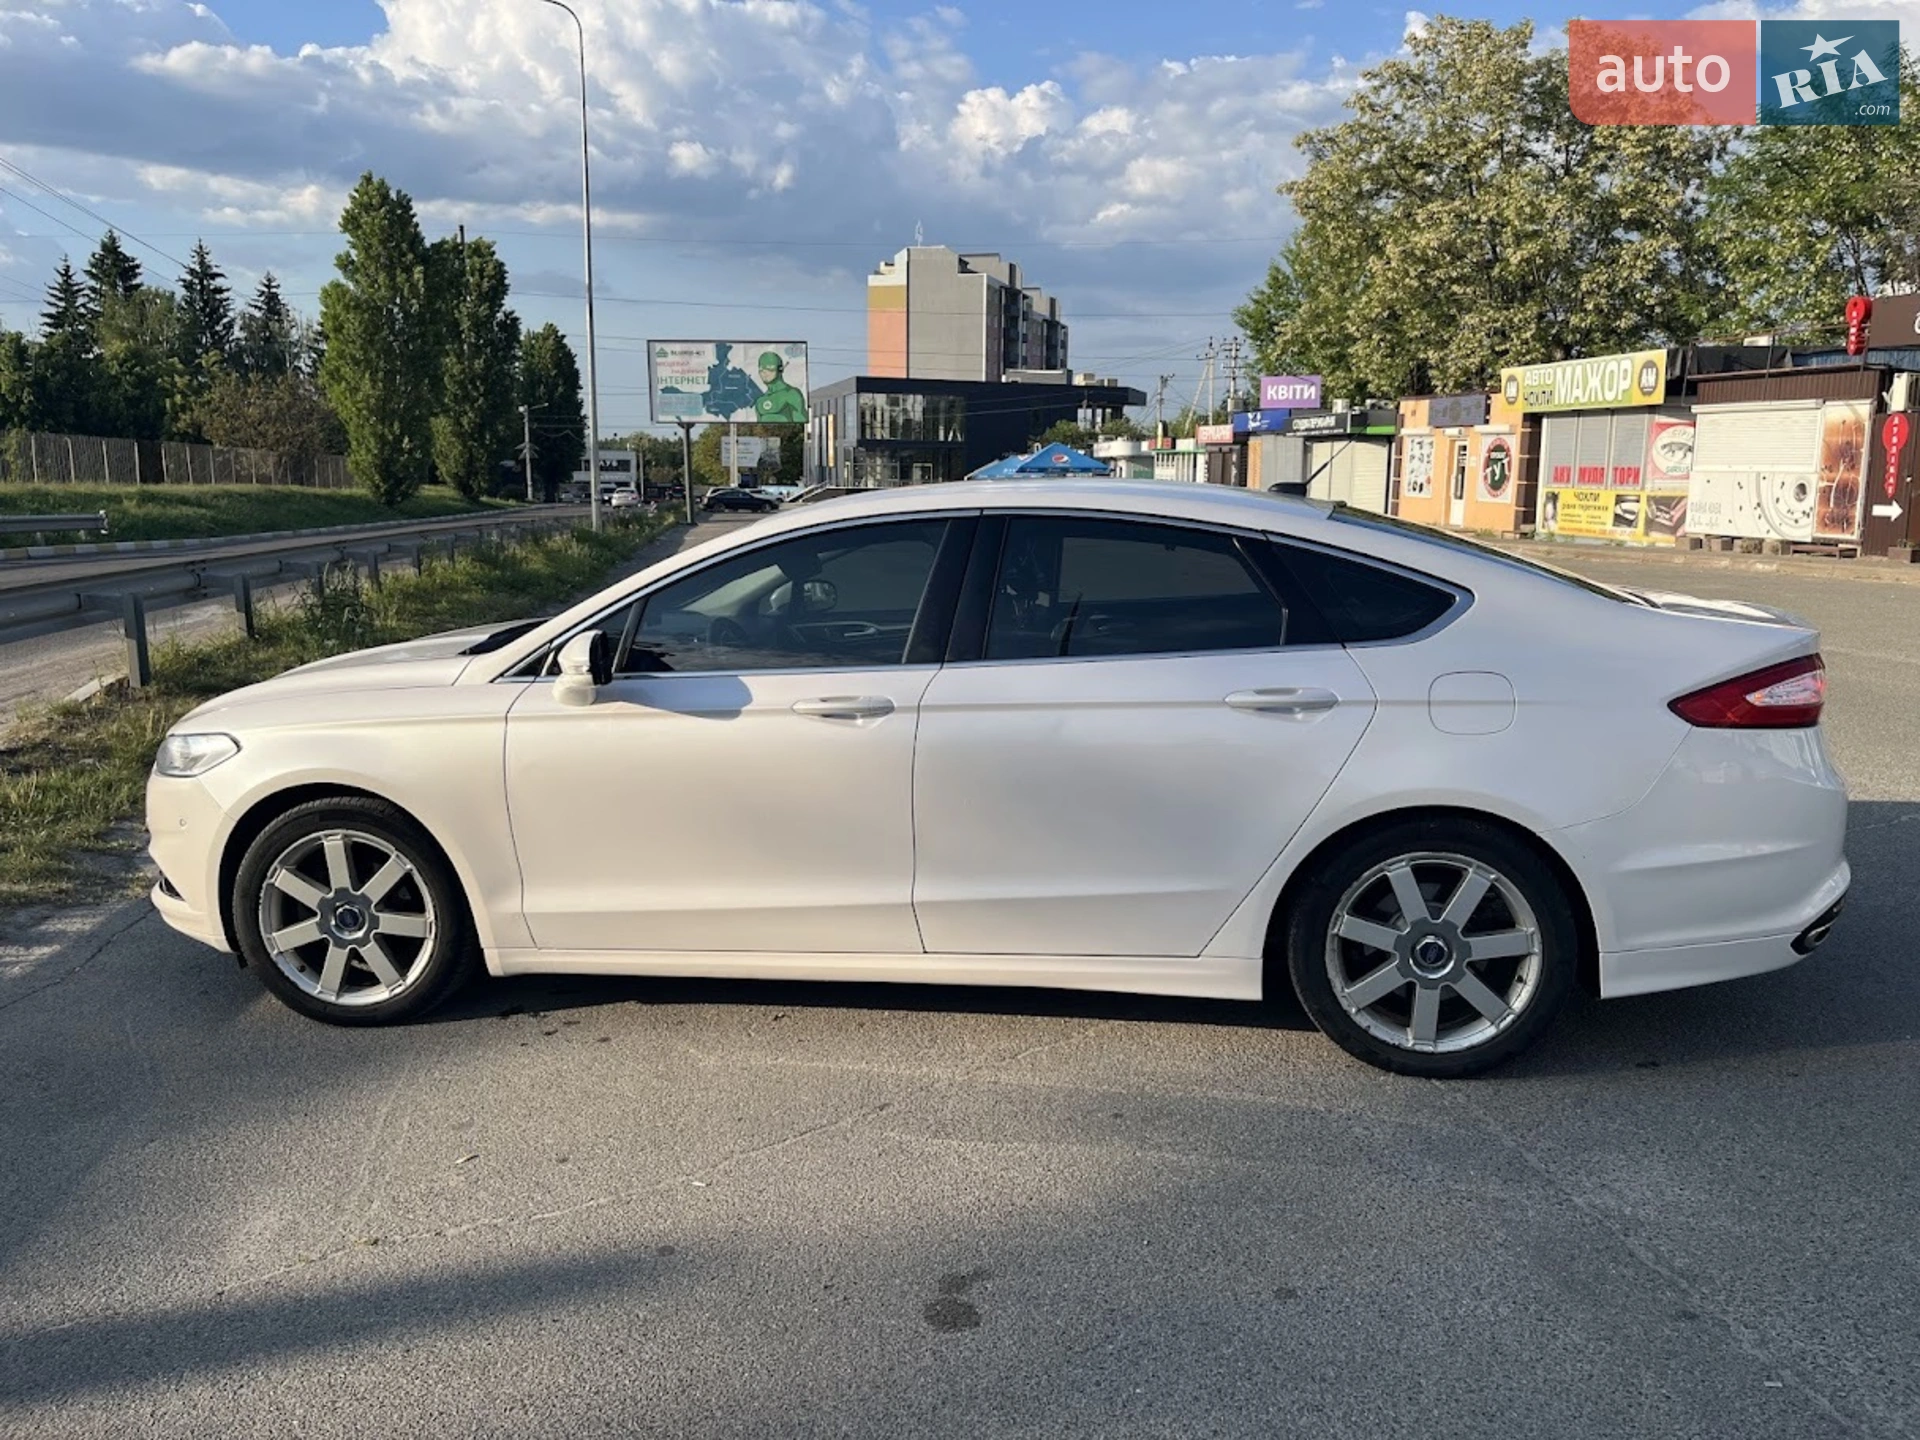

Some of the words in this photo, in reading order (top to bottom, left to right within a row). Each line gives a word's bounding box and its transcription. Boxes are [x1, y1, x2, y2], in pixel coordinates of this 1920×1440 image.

[657, 376, 706, 385] ІНТЕРНЕТ
[1524, 368, 1554, 387] АВТО
[1555, 359, 1633, 406] МАЖОР
[1267, 384, 1316, 400] КВІТИ
[1523, 389, 1553, 407] ЧОХЛИ
[1553, 465, 1572, 484] АКУ
[1577, 465, 1605, 484] МУЛЯ
[1612, 466, 1641, 485] ТОРИ
[1573, 491, 1600, 502] ЧОХЛИ
